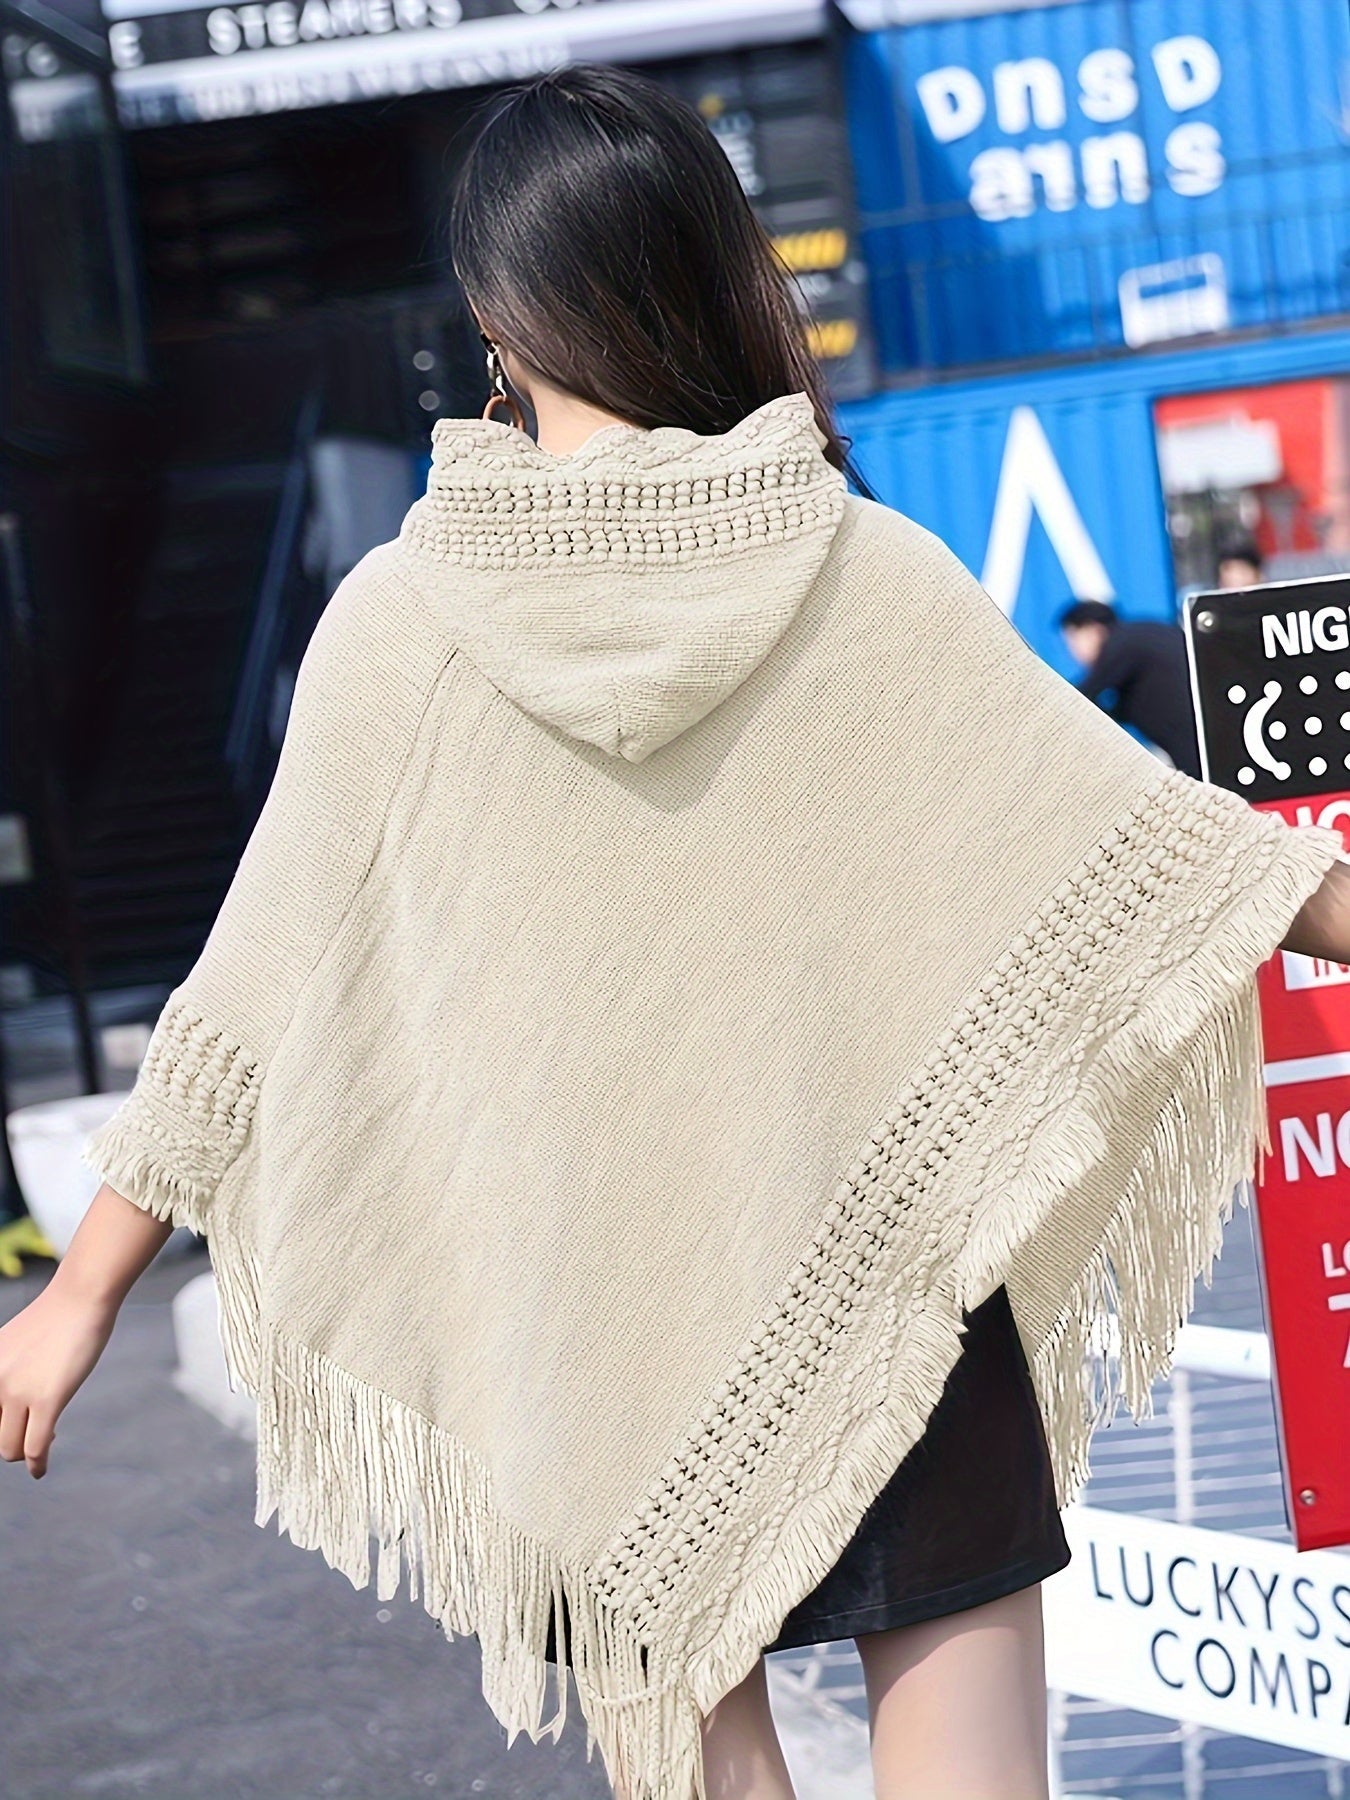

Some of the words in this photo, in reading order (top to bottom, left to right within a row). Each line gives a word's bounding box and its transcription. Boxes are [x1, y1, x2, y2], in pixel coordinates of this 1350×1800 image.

[205, 0, 463, 56] STEAMERS
[1261, 606, 1350, 659] NIG
[1151, 1628, 1350, 1727] COMP
